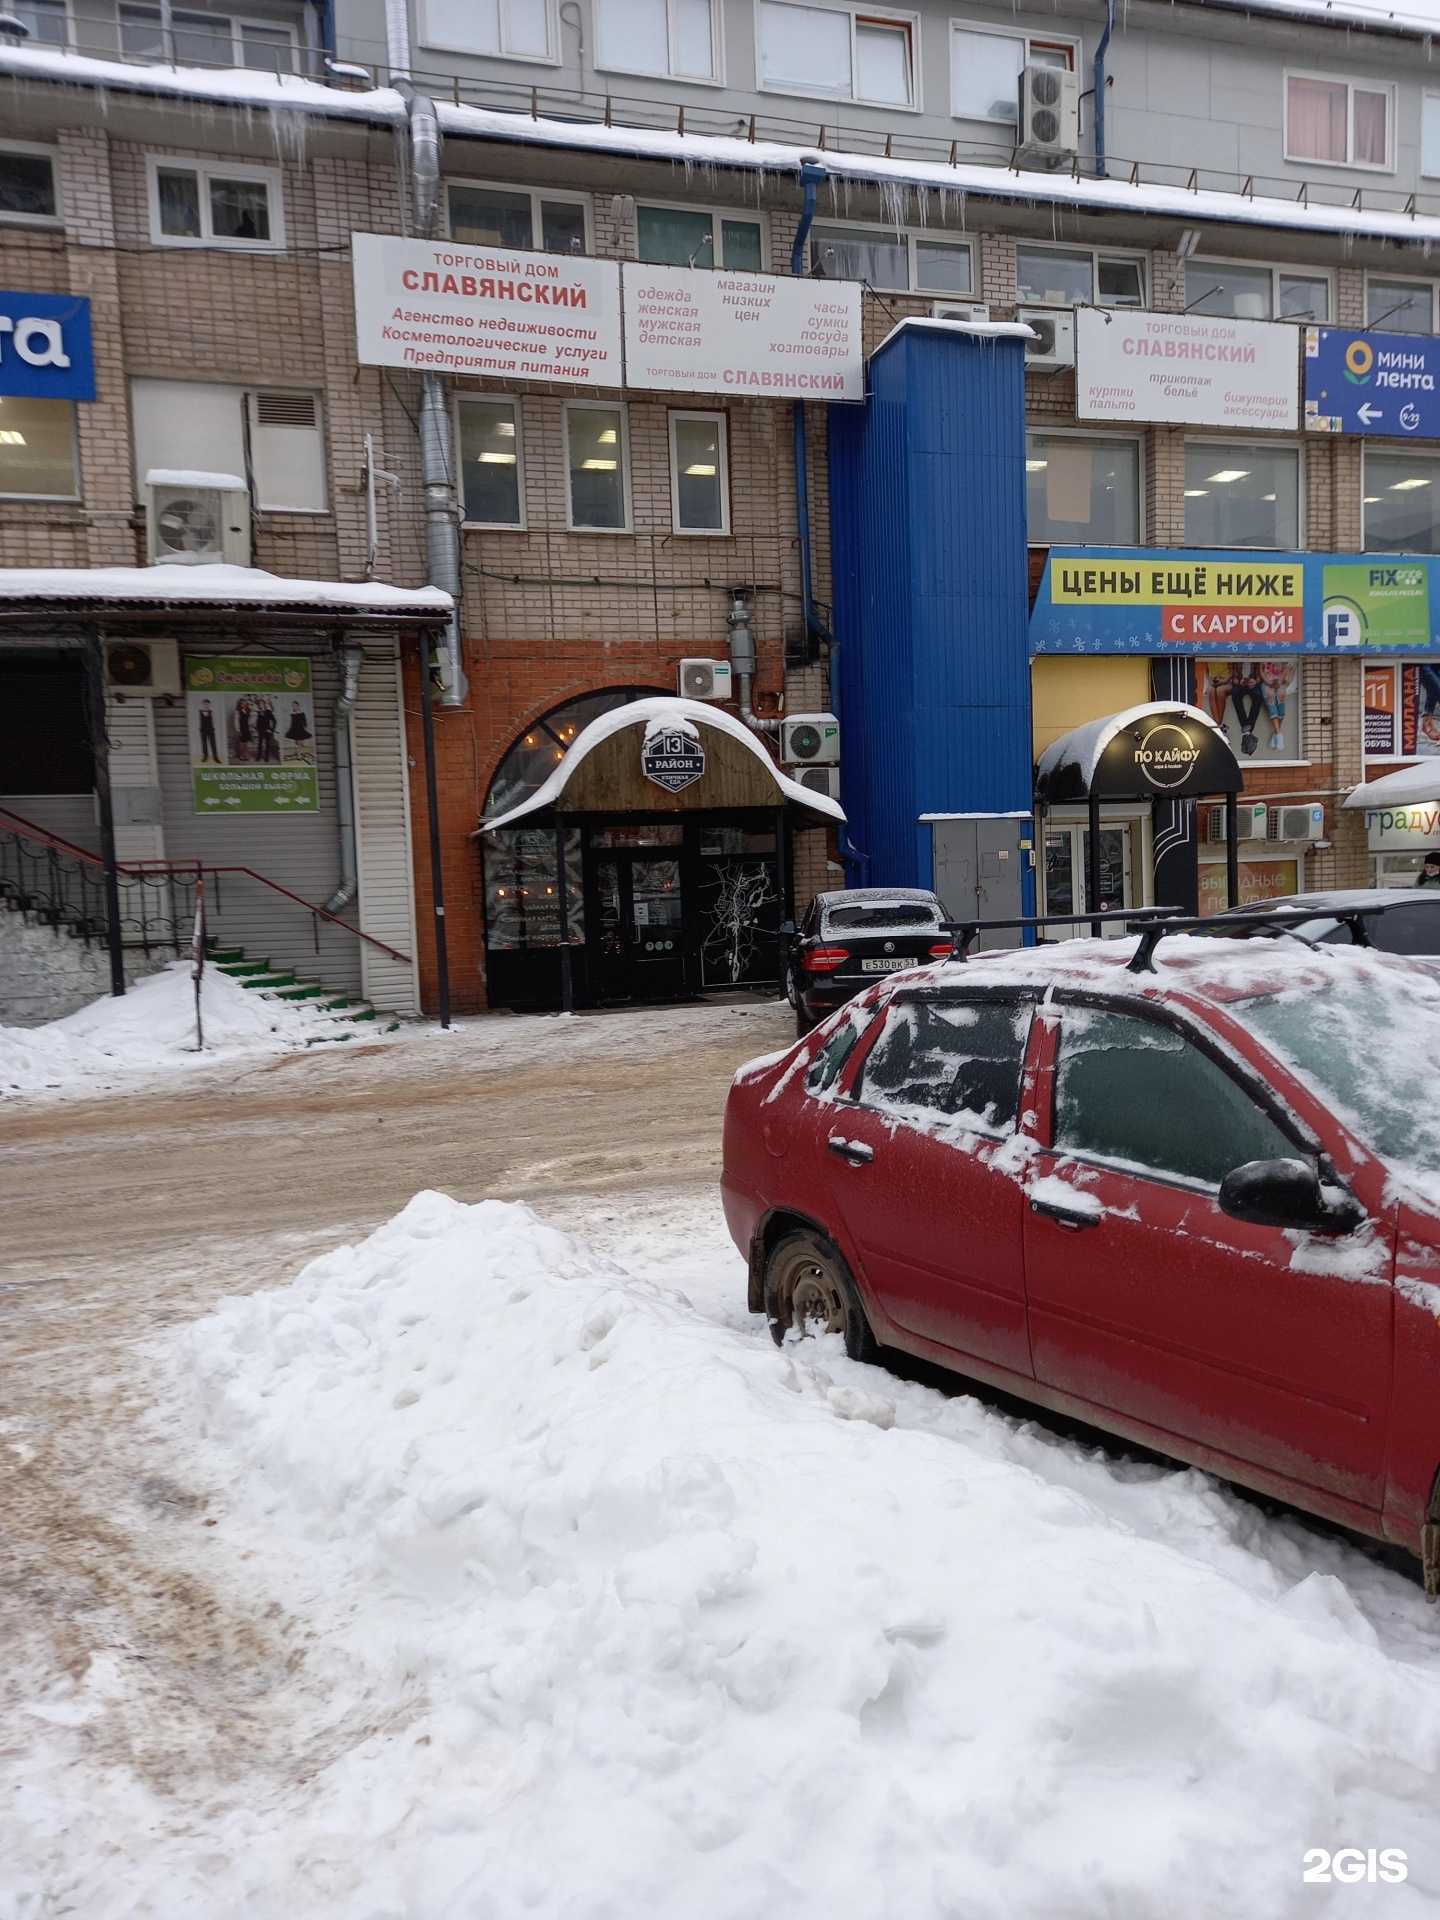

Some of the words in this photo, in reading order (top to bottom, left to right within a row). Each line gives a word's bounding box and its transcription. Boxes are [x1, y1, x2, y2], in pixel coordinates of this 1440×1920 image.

[433, 252, 521, 274] ТОРГОВЫЙ
[525, 264, 559, 278] ДОМ
[402, 270, 587, 309] СЛАВЯНСКИЙ
[638, 287, 692, 303] одежда
[717, 280, 776, 294] магазин
[722, 294, 772, 308] низких
[813, 303, 849, 315] часы
[392, 307, 474, 328] Агенство
[638, 303, 698, 318] женская
[735, 309, 760, 323] цен
[638, 319, 701, 334] мужская
[807, 316, 849, 330] сумки
[1145, 322, 1209, 337] ТОРГОВЫЙ
[1211, 329, 1237, 340] ДОМ
[382, 326, 548, 355] Косметологические
[555, 345, 608, 362] услуги
[639, 330, 701, 347] детская
[800, 329, 849, 344] посуда
[769, 342, 849, 359] хозтовары
[1122, 337, 1256, 364] СЛАВЯНСКИЙ
[403, 347, 516, 371] Предприятия
[520, 361, 590, 378] питания
[646, 368, 695, 380] ТОРГОВЫЙ
[697, 371, 717, 380] ДОМ
[723, 369, 845, 390] СЛАВЯНСКИЙ
[1149, 372, 1214, 388] трикотаж
[1089, 385, 1135, 399] куртки
[1163, 384, 1198, 398] бельё
[1089, 398, 1136, 411] пальто
[1224, 391, 1288, 409] бижутерия
[1223, 405, 1289, 421] аксессуары
[1062, 570, 1141, 596] ЦЕНЫ
[1151, 567, 1207, 598] ЕЩЁ
[1216, 573, 1294, 596] НИЖЕ
[1170, 615, 1185, 634] С
[1192, 611, 1294, 634] КАРТОЙ!
[1366, 683, 1387, 708] 11
[1403, 667, 1415, 752] МИЛАНА
[666, 737, 681, 753] 13
[1134, 750, 1153, 763] ПО
[1154, 747, 1201, 763] КАЙФУ
[655, 758, 694, 769] РАЙОН
[200, 771, 264, 781] ШКОЛЬНАЯ
[271, 771, 311, 780] ФОРМА
[1367, 810, 1440, 837] граду
